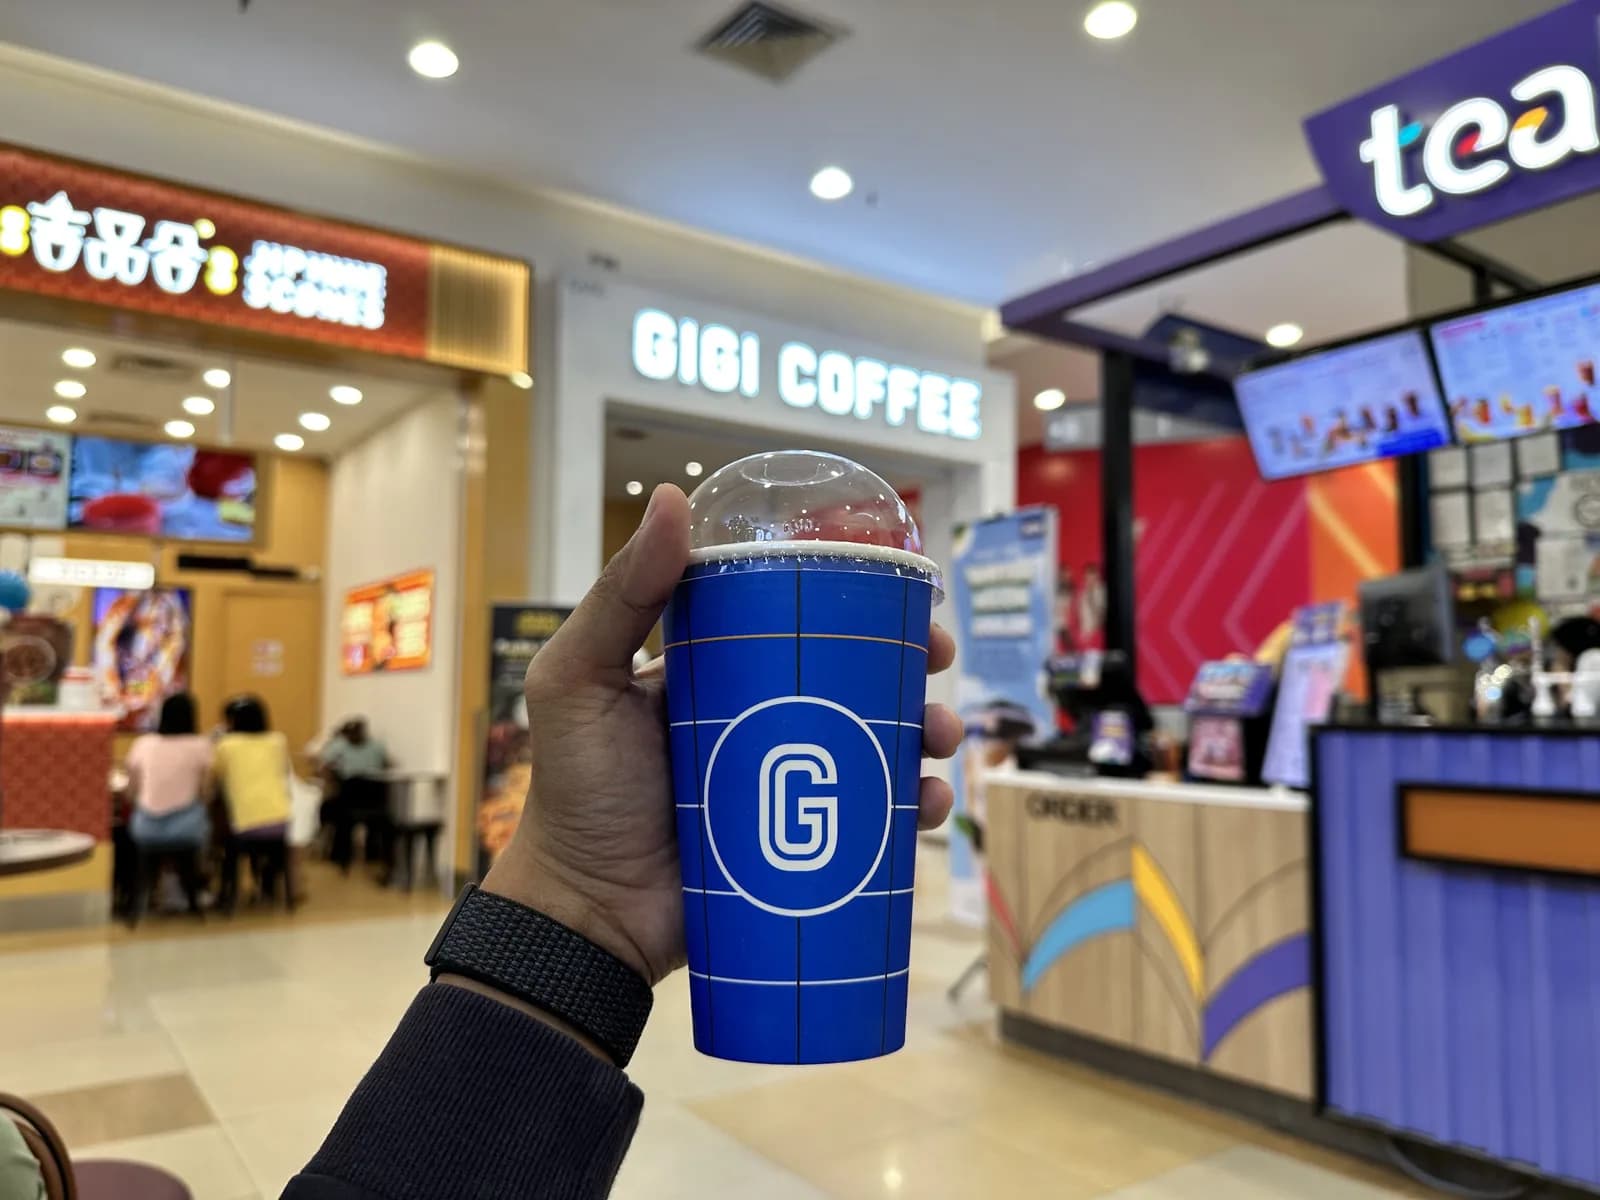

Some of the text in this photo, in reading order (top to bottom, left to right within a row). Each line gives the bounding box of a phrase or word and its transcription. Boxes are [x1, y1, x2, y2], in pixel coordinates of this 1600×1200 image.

[633, 308, 982, 440] GIGI COFFEE
[759, 743, 838, 872] G
